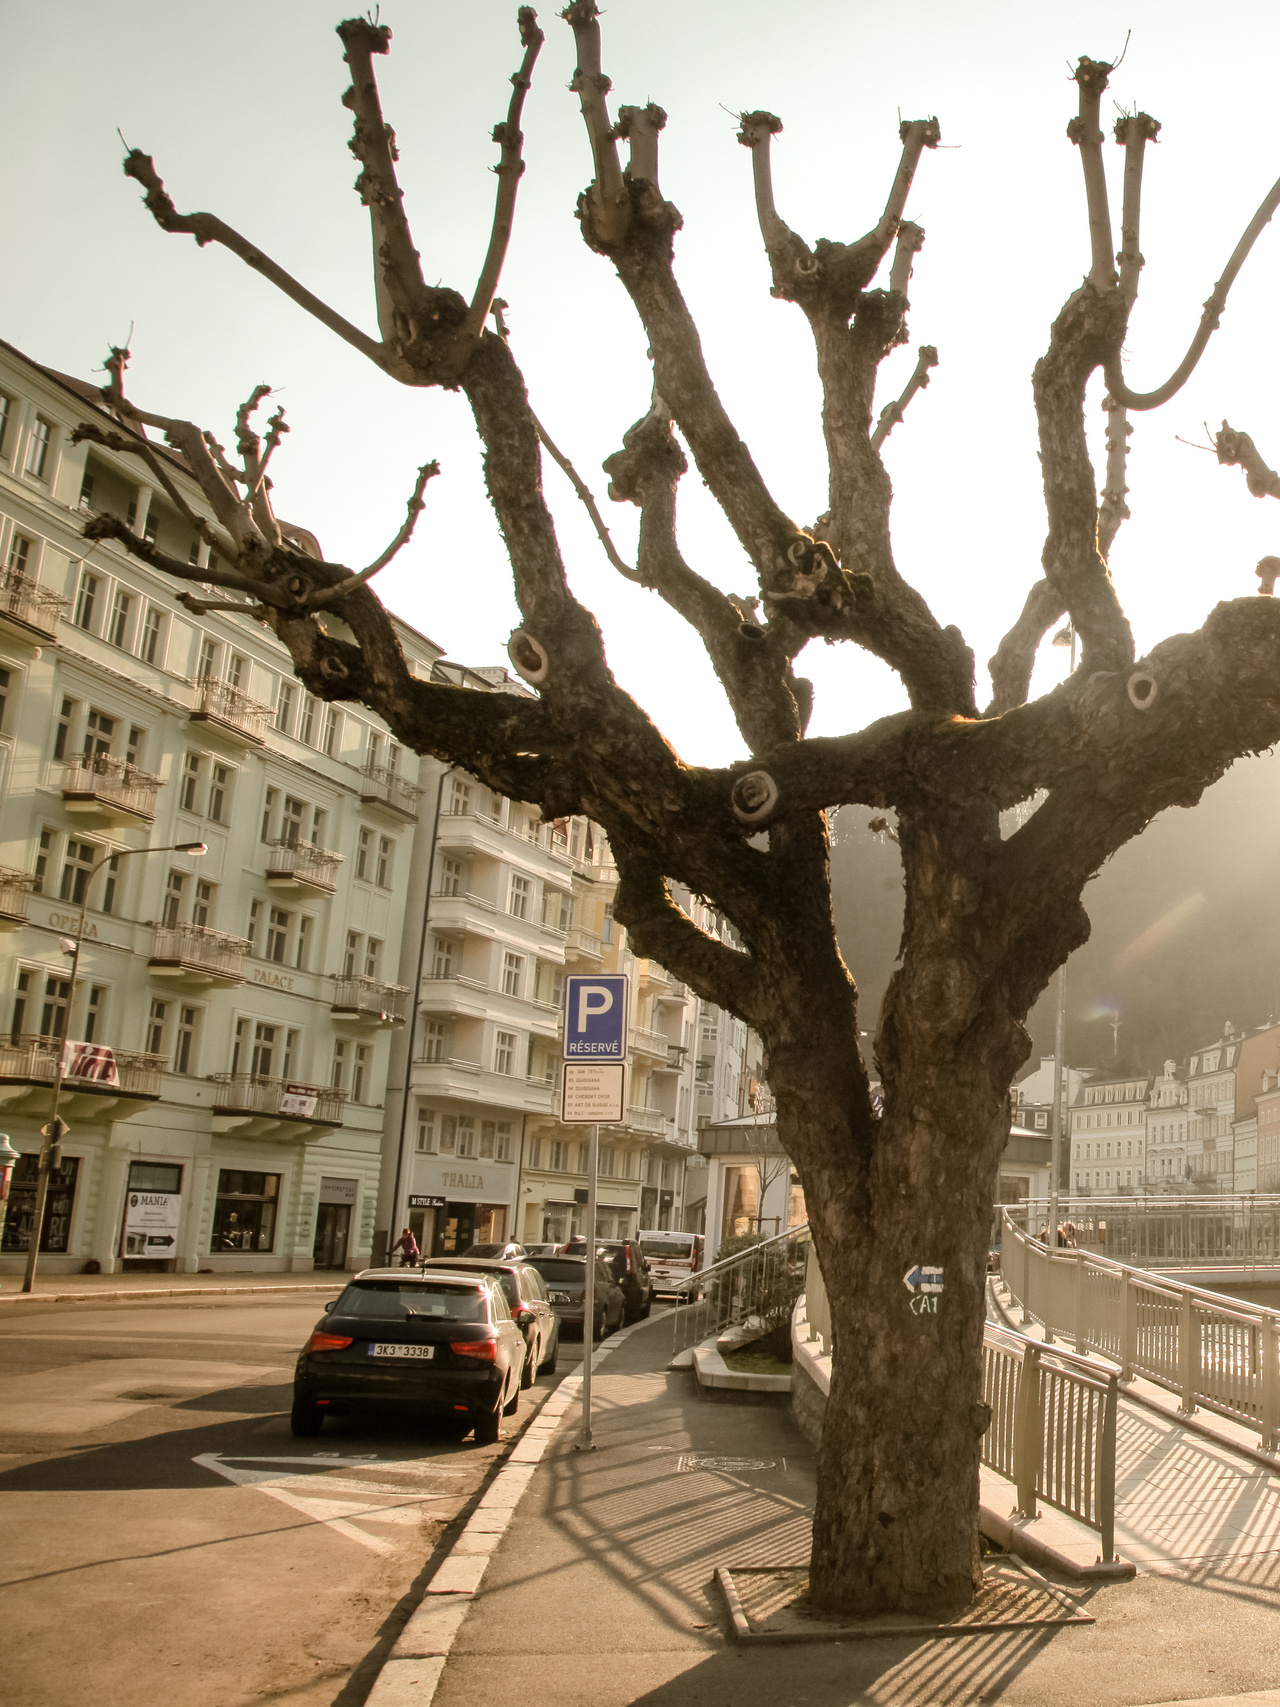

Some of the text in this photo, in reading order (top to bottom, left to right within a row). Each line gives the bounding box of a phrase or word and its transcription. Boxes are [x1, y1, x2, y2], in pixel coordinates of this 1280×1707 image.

[48, 912, 98, 939] OPERA
[253, 968, 294, 990] PALACE
[577, 985, 614, 1033] P
[569, 1040, 619, 1053] RÉSERVÉ
[442, 1172, 484, 1189] THALIA
[140, 1195, 168, 1206] MANIA
[417, 1197, 431, 1206] STYLE
[376, 1345, 396, 1356] 3K3
[403, 1346, 430, 1357] 3338
